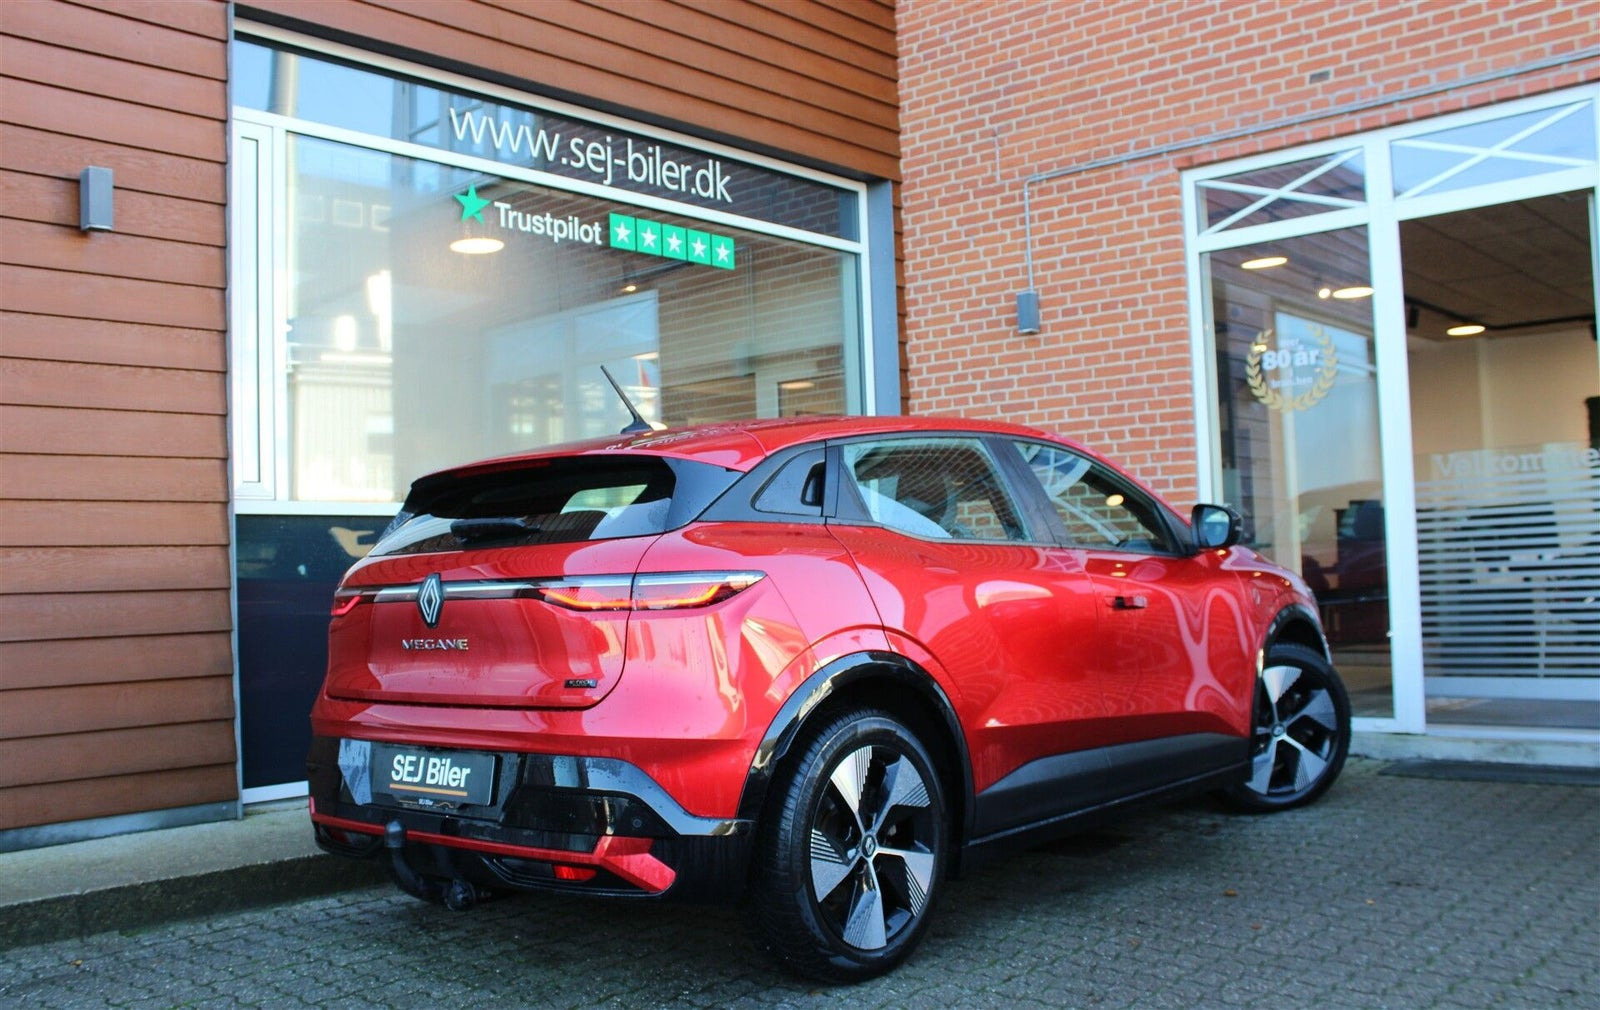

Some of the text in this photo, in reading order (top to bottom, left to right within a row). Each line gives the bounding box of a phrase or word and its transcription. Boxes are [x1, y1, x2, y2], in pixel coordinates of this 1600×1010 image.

[449, 107, 733, 203] www.sej-biler.dk
[494, 201, 603, 244] Trustpilot
[1261, 345, 1320, 371] 80 år
[402, 638, 469, 651] MEGANE
[391, 754, 471, 788] SEJ Biler
